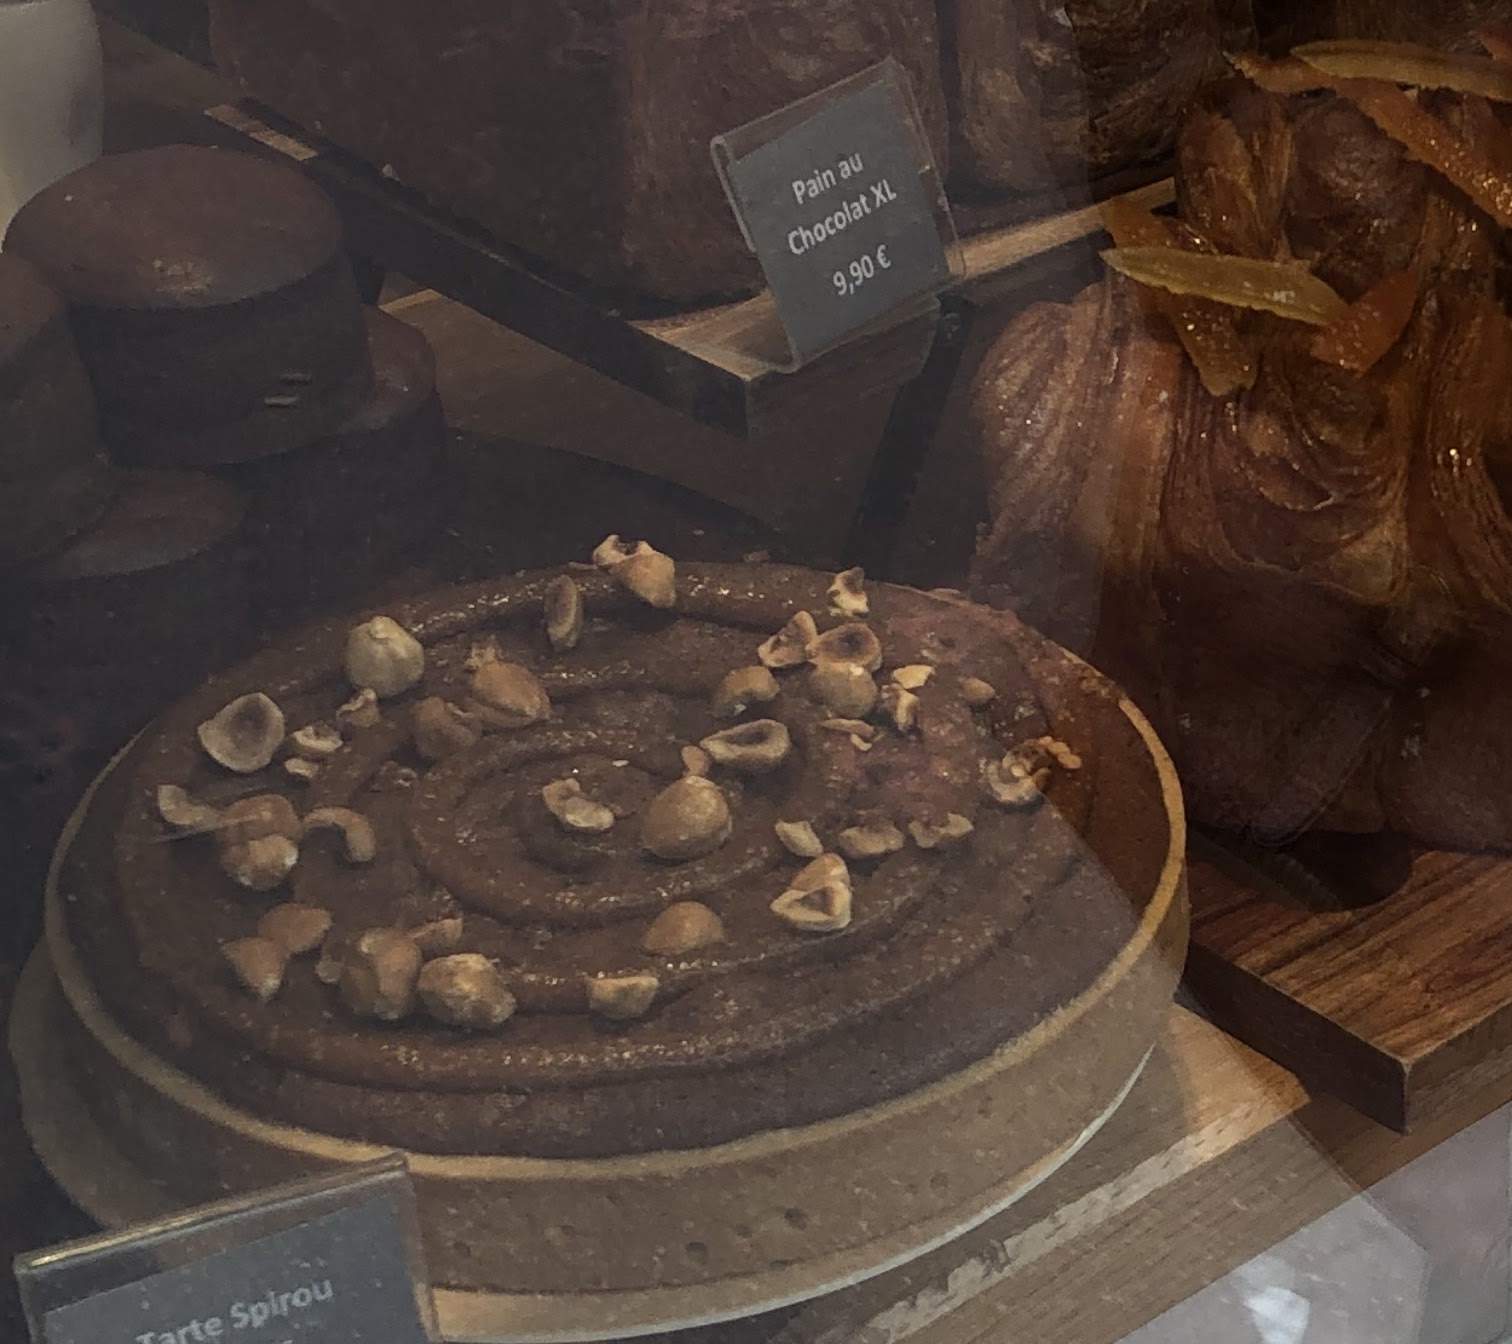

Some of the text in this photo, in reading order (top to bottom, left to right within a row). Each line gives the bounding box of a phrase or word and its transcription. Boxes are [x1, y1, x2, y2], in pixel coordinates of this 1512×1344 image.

[792, 153, 864, 205] Pain au
[787, 179, 897, 255] Chocolat XL
[832, 244, 892, 296] 9,90 €
[230, 1279, 334, 1329] Spirou
